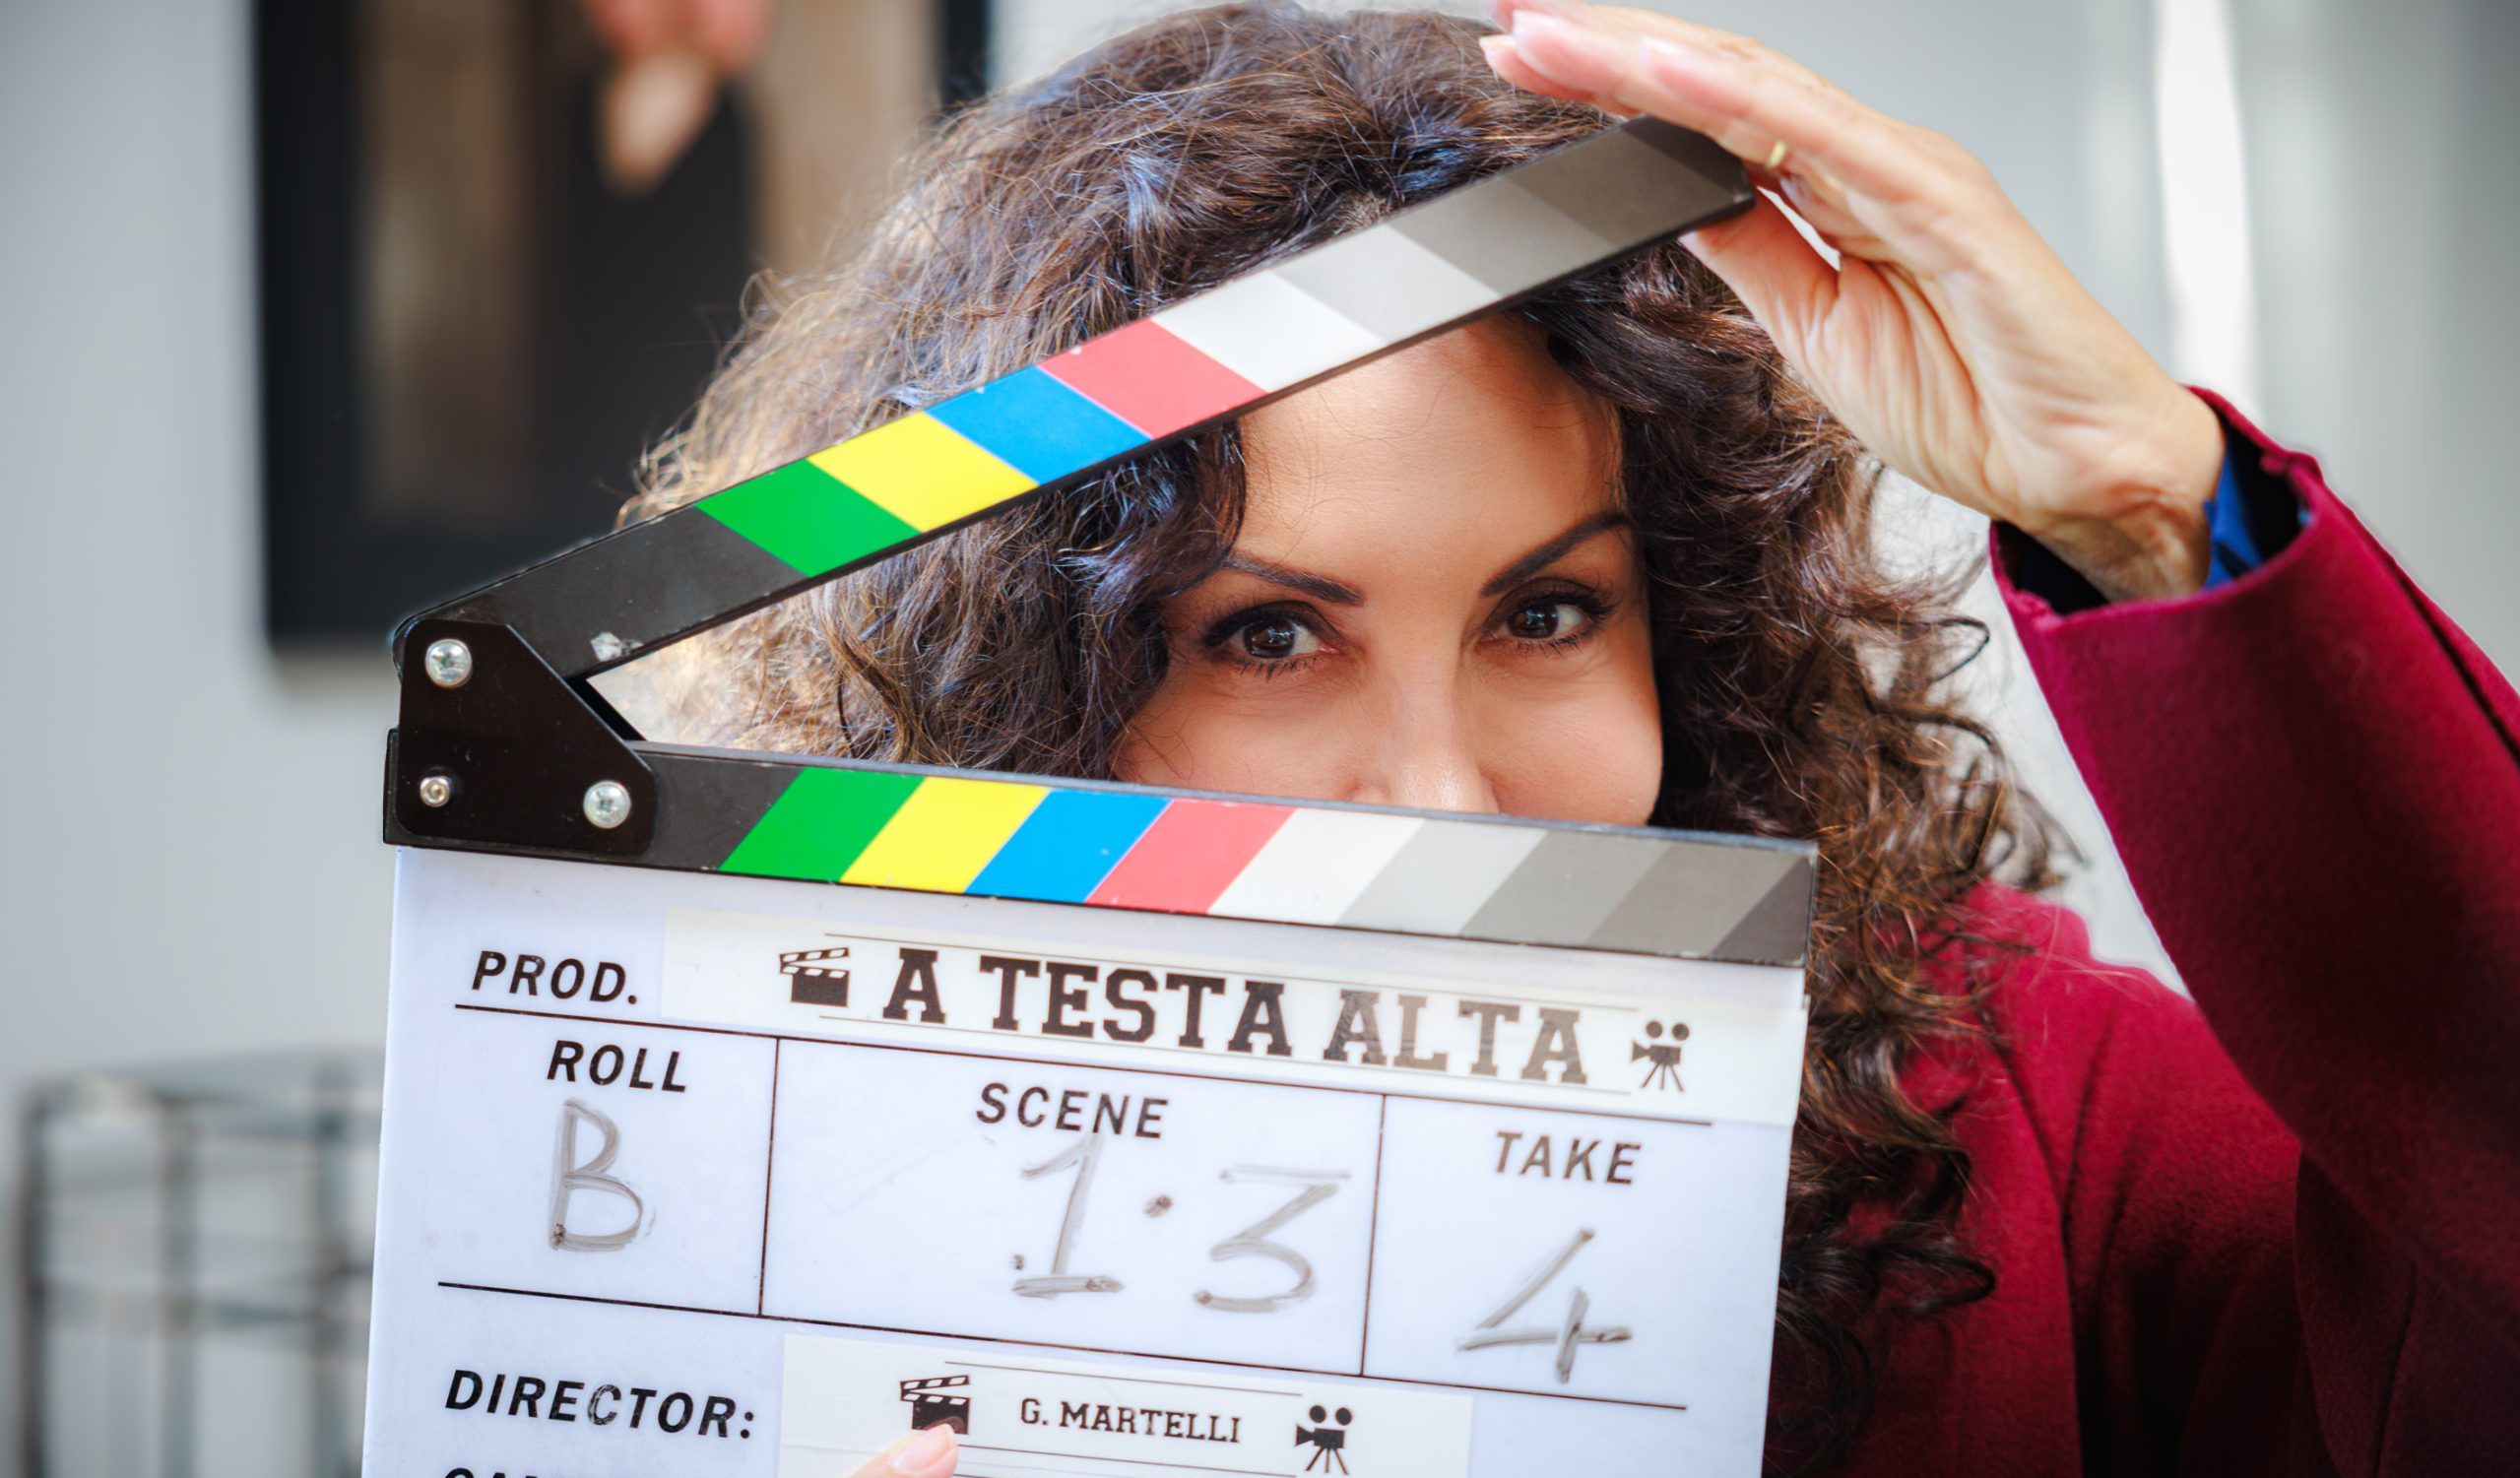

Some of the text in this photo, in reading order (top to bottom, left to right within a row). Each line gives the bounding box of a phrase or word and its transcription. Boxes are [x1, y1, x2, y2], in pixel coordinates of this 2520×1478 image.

[471, 949, 638, 1005] PROD.
[882, 947, 1588, 1084] A TESTA ALTA
[547, 1040, 687, 1093] ROLL
[976, 1083, 1170, 1139] SCENE
[549, 1097, 645, 1252] B
[1495, 1130, 1642, 1186] TAKE
[1456, 1228, 1634, 1382] 4
[444, 1370, 754, 1440] DIRECTOR:
[1020, 1398, 1241, 1445] G. MARTELLI
